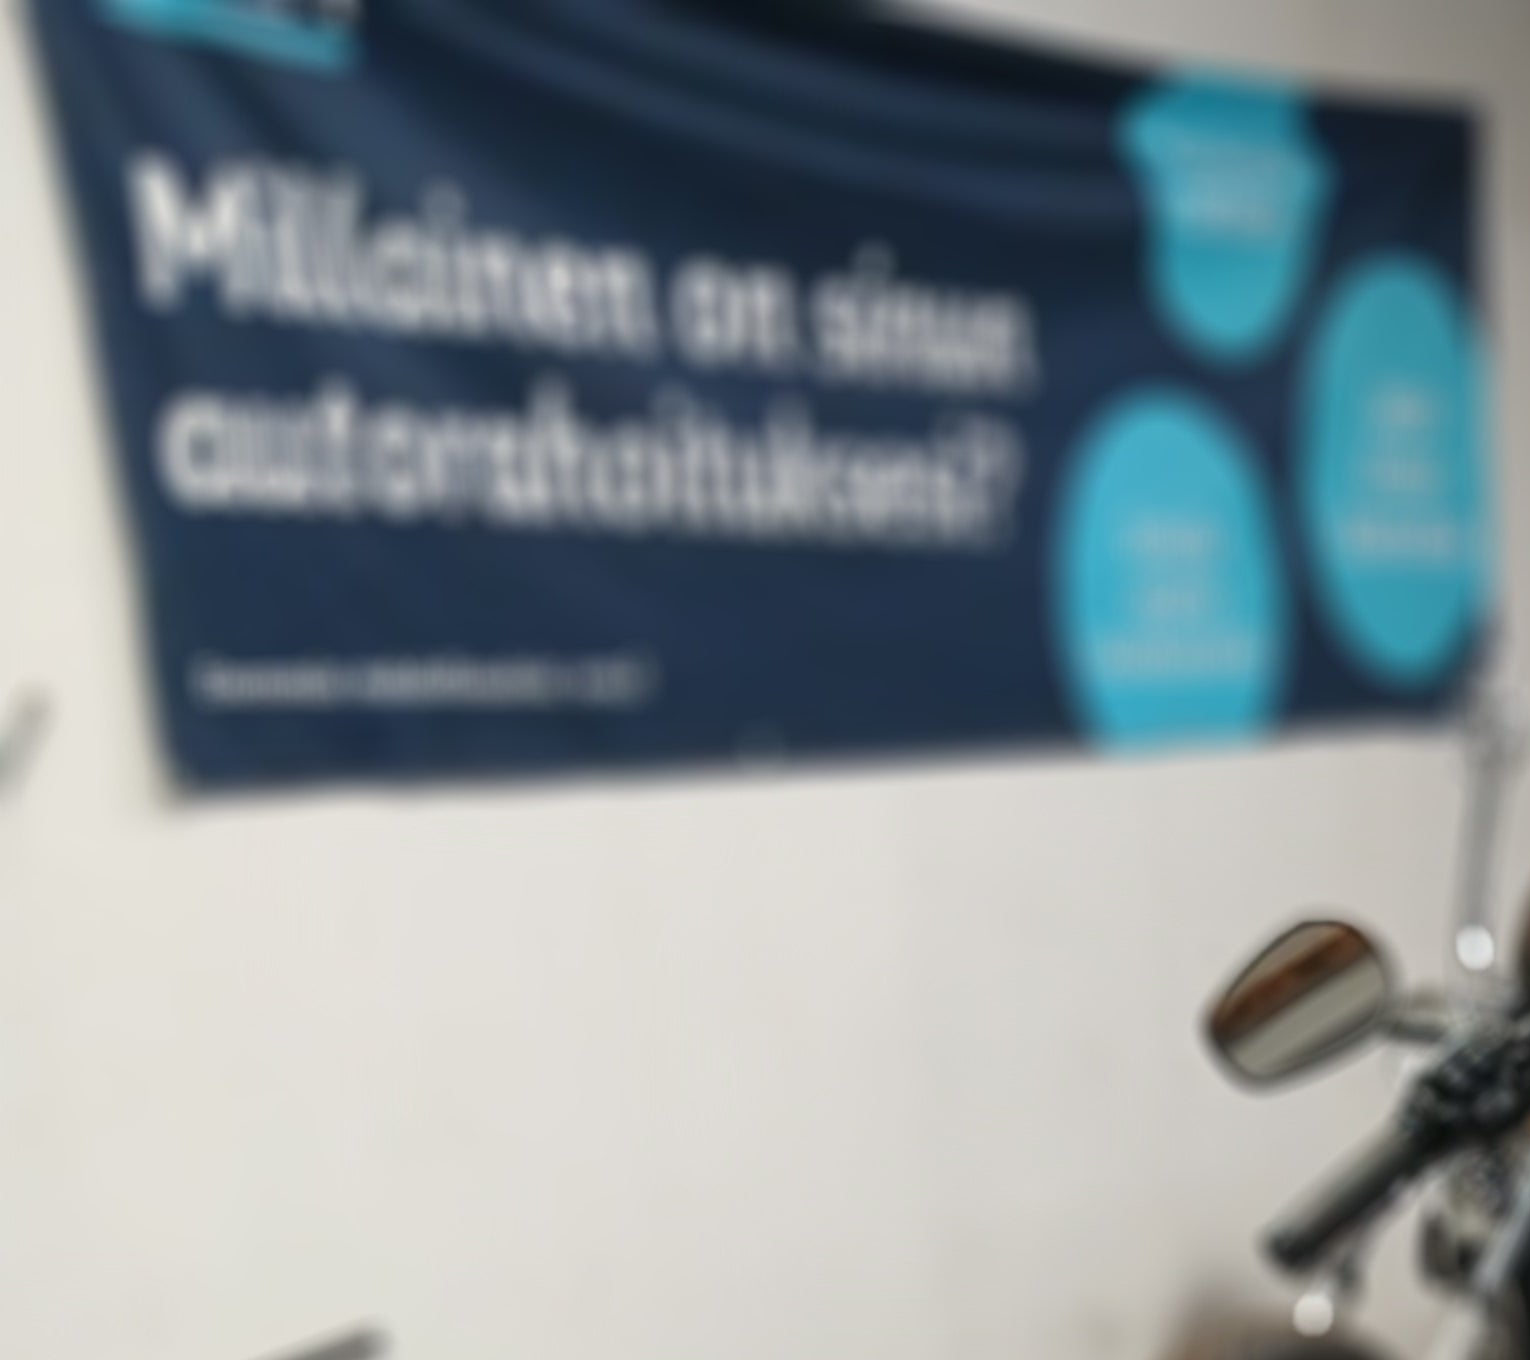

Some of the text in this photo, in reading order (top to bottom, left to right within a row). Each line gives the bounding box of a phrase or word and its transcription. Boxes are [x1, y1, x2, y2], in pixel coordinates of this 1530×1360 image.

[130, 158, 1032, 388] Millainen on sinun
